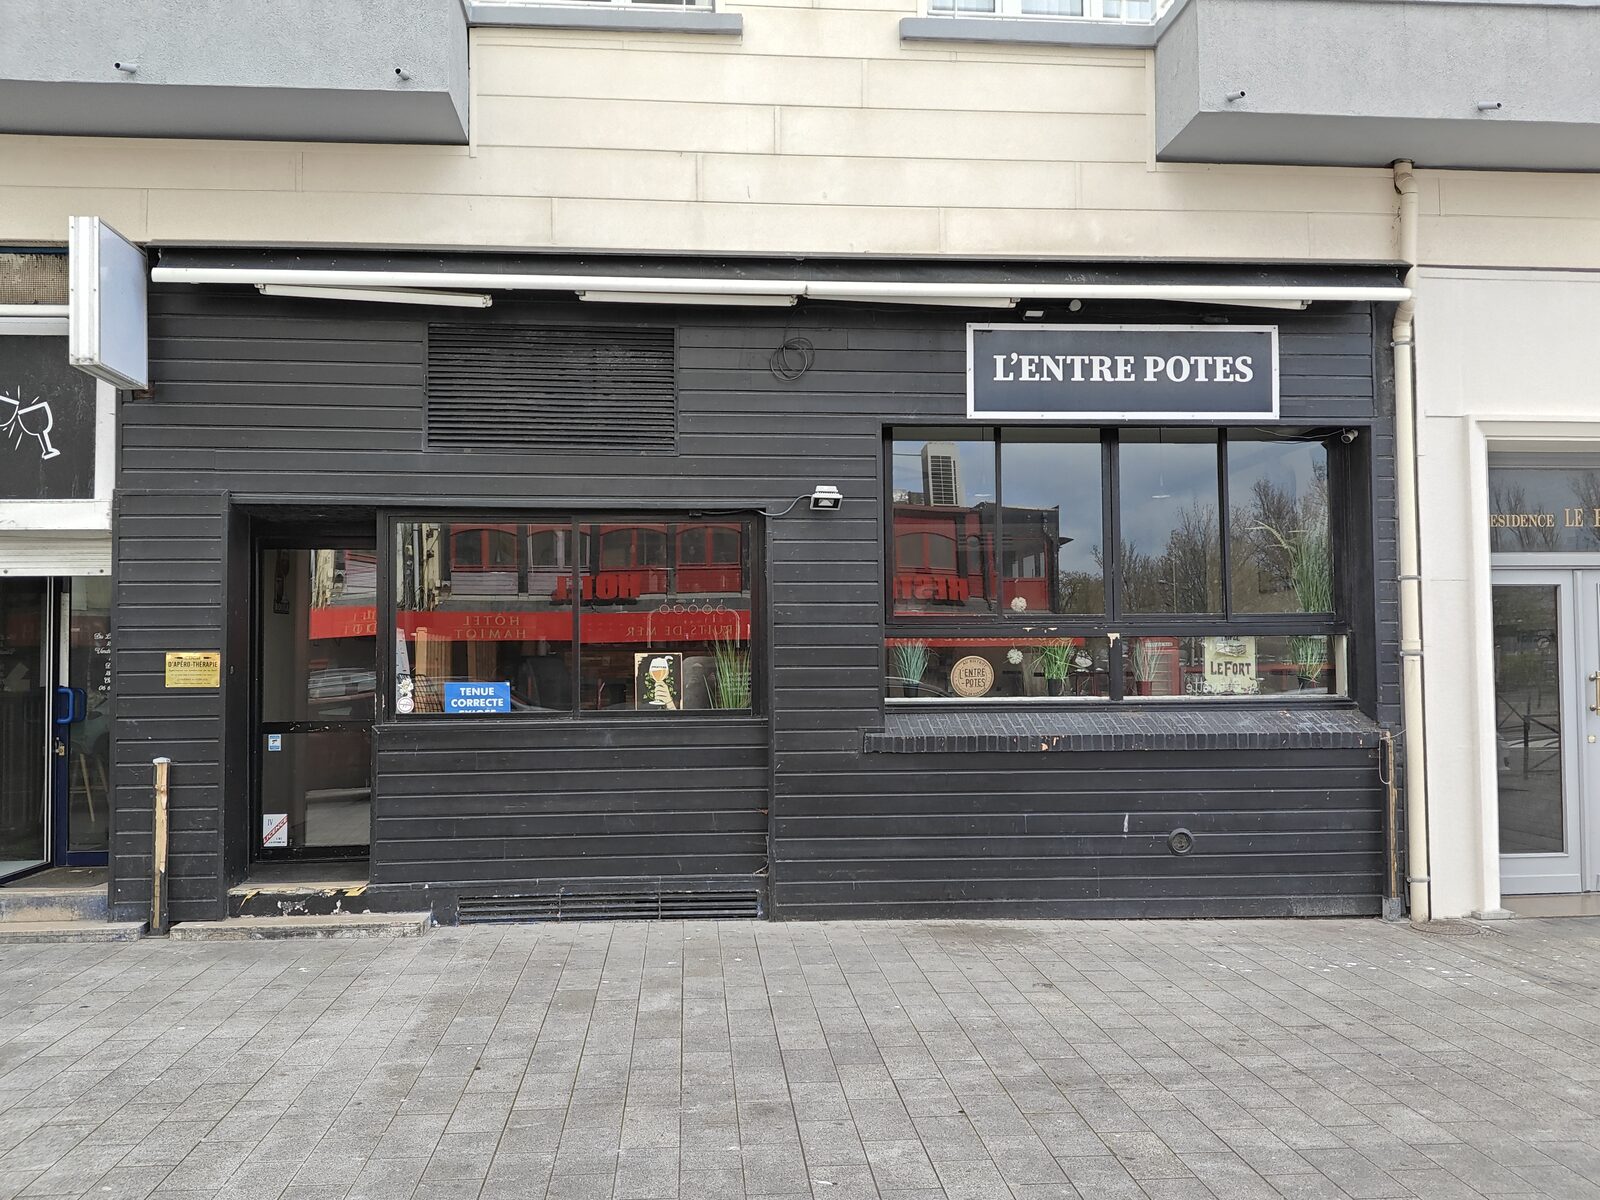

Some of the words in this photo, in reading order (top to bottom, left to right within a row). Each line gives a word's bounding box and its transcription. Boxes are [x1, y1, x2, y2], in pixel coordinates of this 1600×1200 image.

[993, 353, 1136, 382] L'ENTRE
[1143, 355, 1254, 383] POTES
[1489, 514, 1555, 528] ESIDENCE
[1564, 508, 1584, 527] LE
[460, 687, 495, 696] TENUE
[450, 698, 504, 707] CORRECTE
